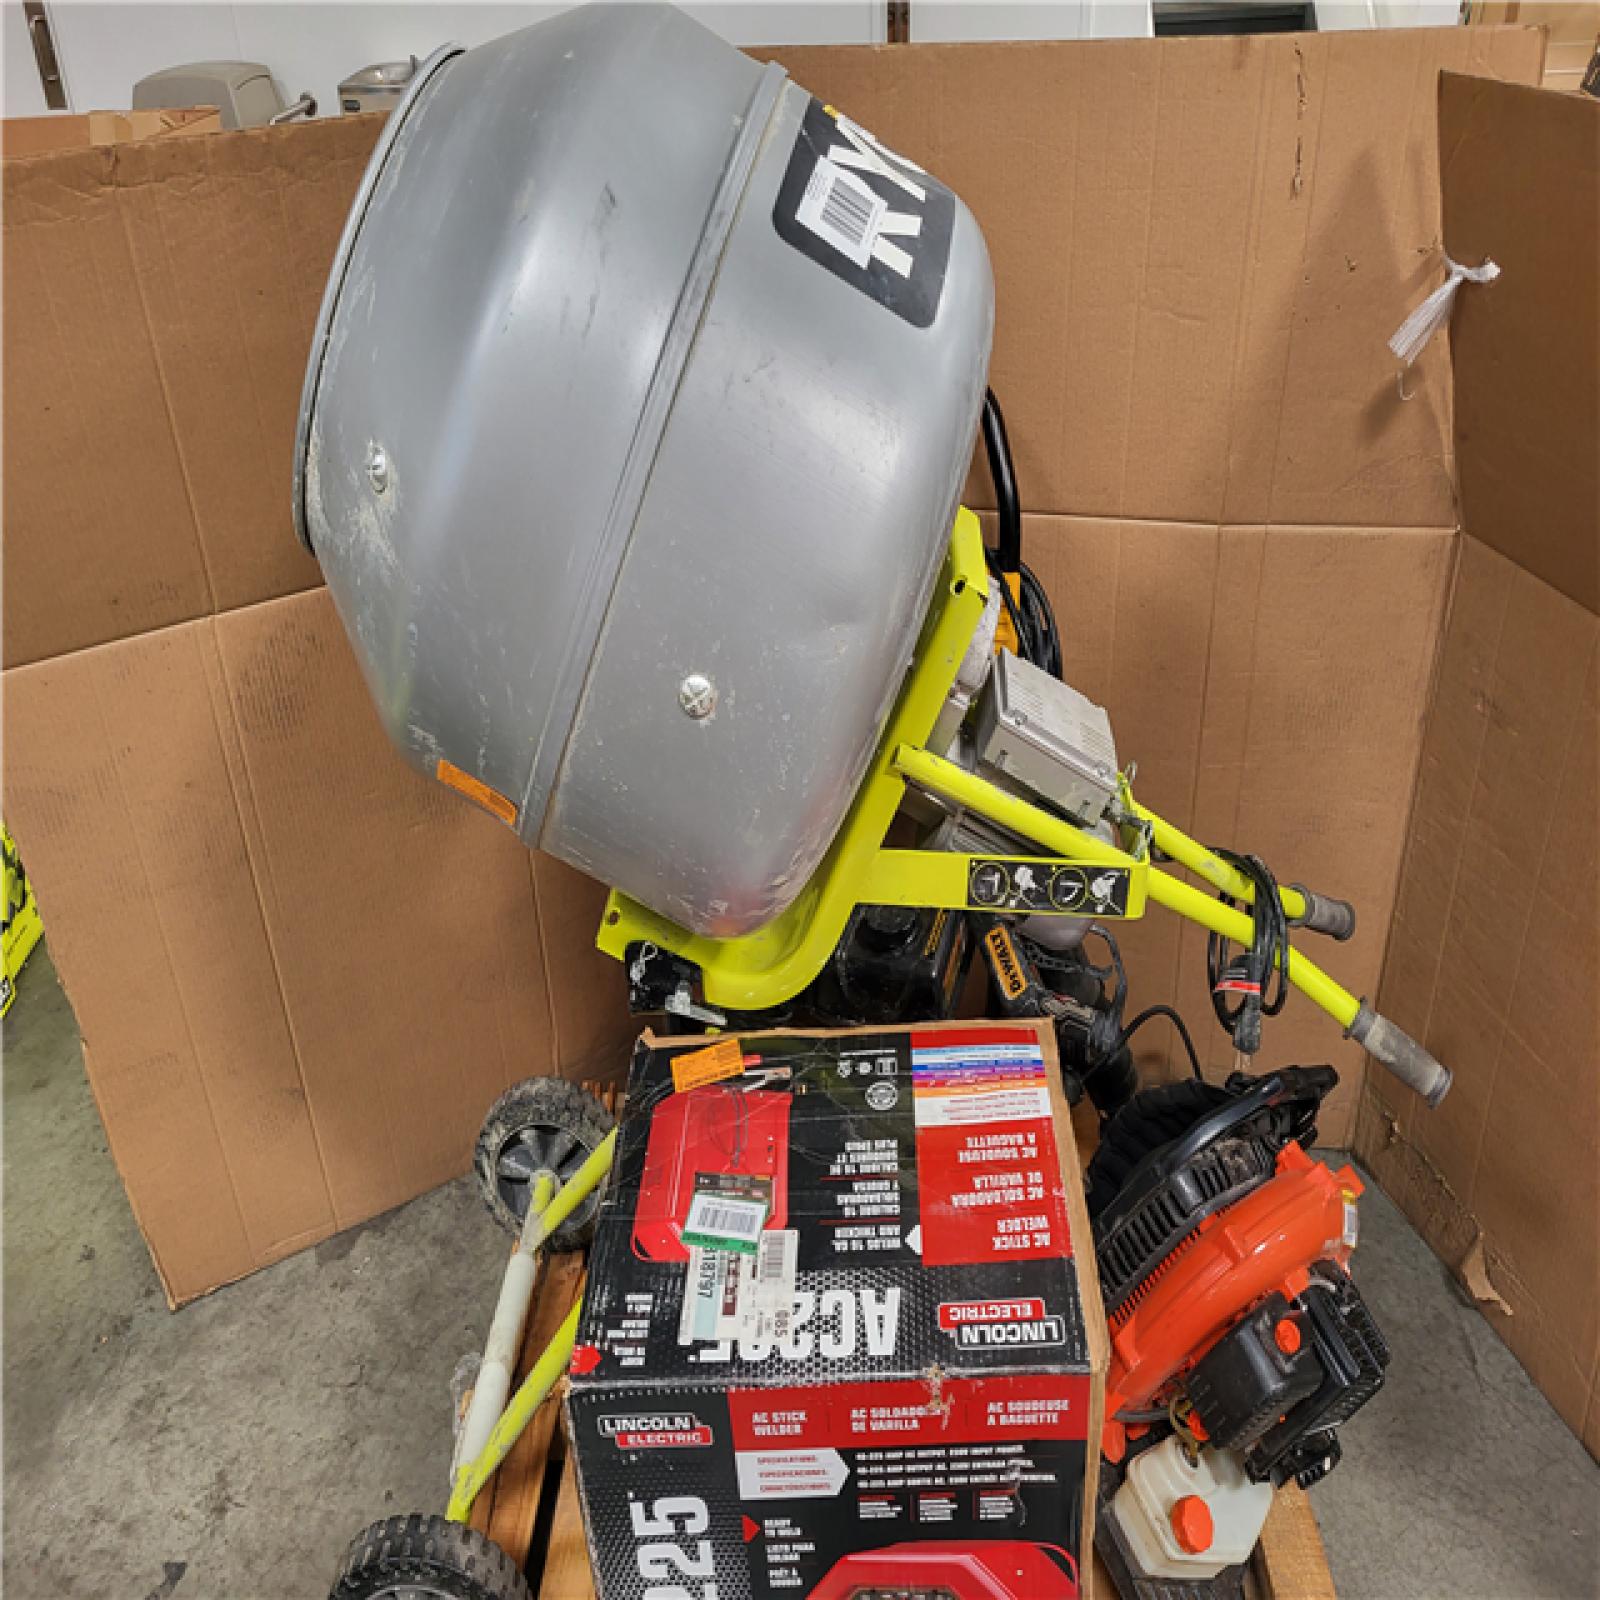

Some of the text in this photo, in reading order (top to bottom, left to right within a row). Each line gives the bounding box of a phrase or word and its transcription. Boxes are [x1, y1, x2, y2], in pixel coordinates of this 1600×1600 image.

[997, 1215, 1049, 1233] WELDER
[992, 1234, 1030, 1250] STICK
[949, 1302, 1032, 1321] ELECTRIC
[961, 1321, 1059, 1343] LINCOLN
[603, 1416, 691, 1431] LINCOLN
[771, 1411, 808, 1423] STICK
[754, 1424, 803, 1436] WELDER
[626, 1431, 702, 1445] ELECTRIC
